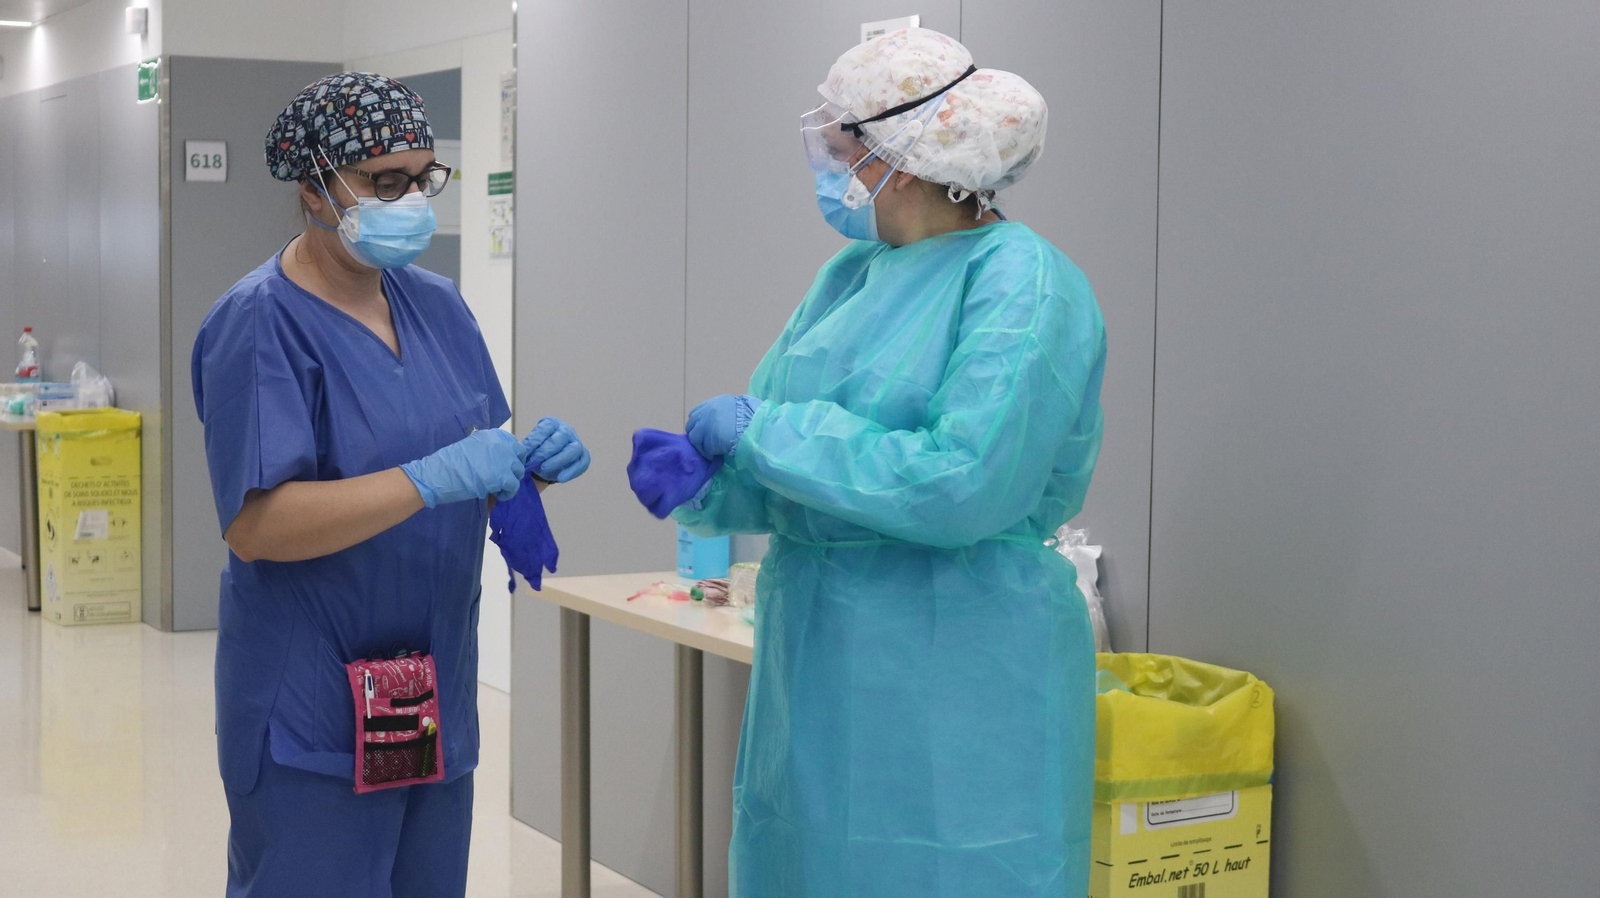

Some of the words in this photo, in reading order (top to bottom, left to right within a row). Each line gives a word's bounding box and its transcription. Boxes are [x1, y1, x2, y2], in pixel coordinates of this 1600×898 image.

[190, 153, 222, 169] 618
[121, 488, 138, 496] MOUS
[1170, 840, 1183, 848] Limite
[1193, 861, 1210, 878] 50
[1212, 860, 1220, 875] L
[1225, 856, 1251, 872] haut
